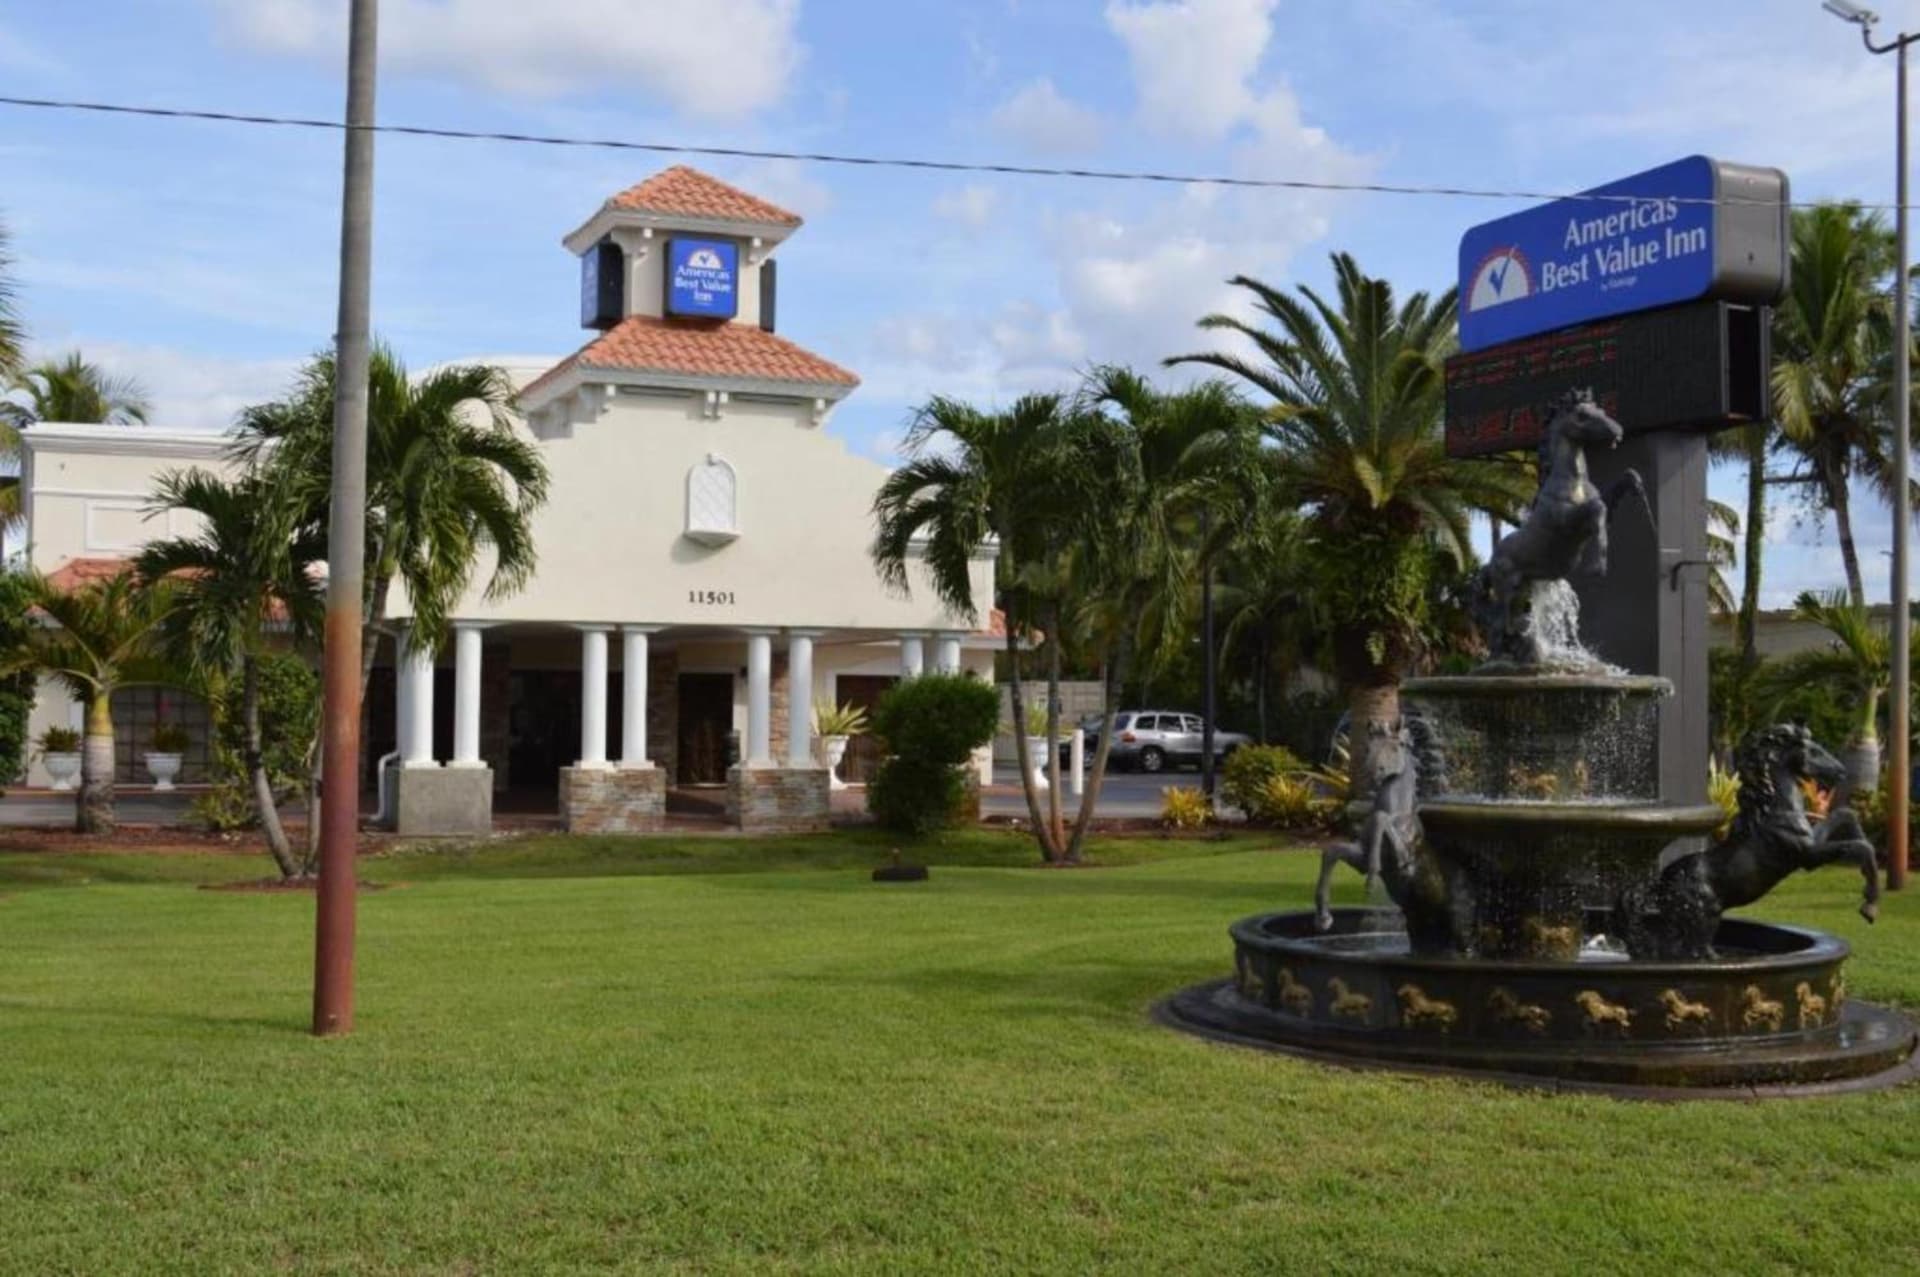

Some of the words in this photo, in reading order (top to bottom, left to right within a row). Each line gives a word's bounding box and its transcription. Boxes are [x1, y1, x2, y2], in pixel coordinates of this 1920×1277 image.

[1564, 196, 1679, 249] Americas
[1542, 254, 1589, 292] Best
[1595, 236, 1660, 276] Value
[1665, 227, 1706, 259] Inn
[676, 265, 730, 280] Americas
[675, 277, 699, 290] Best
[702, 279, 731, 292] Value
[694, 290, 712, 302] Inn
[689, 590, 735, 605] 11501
